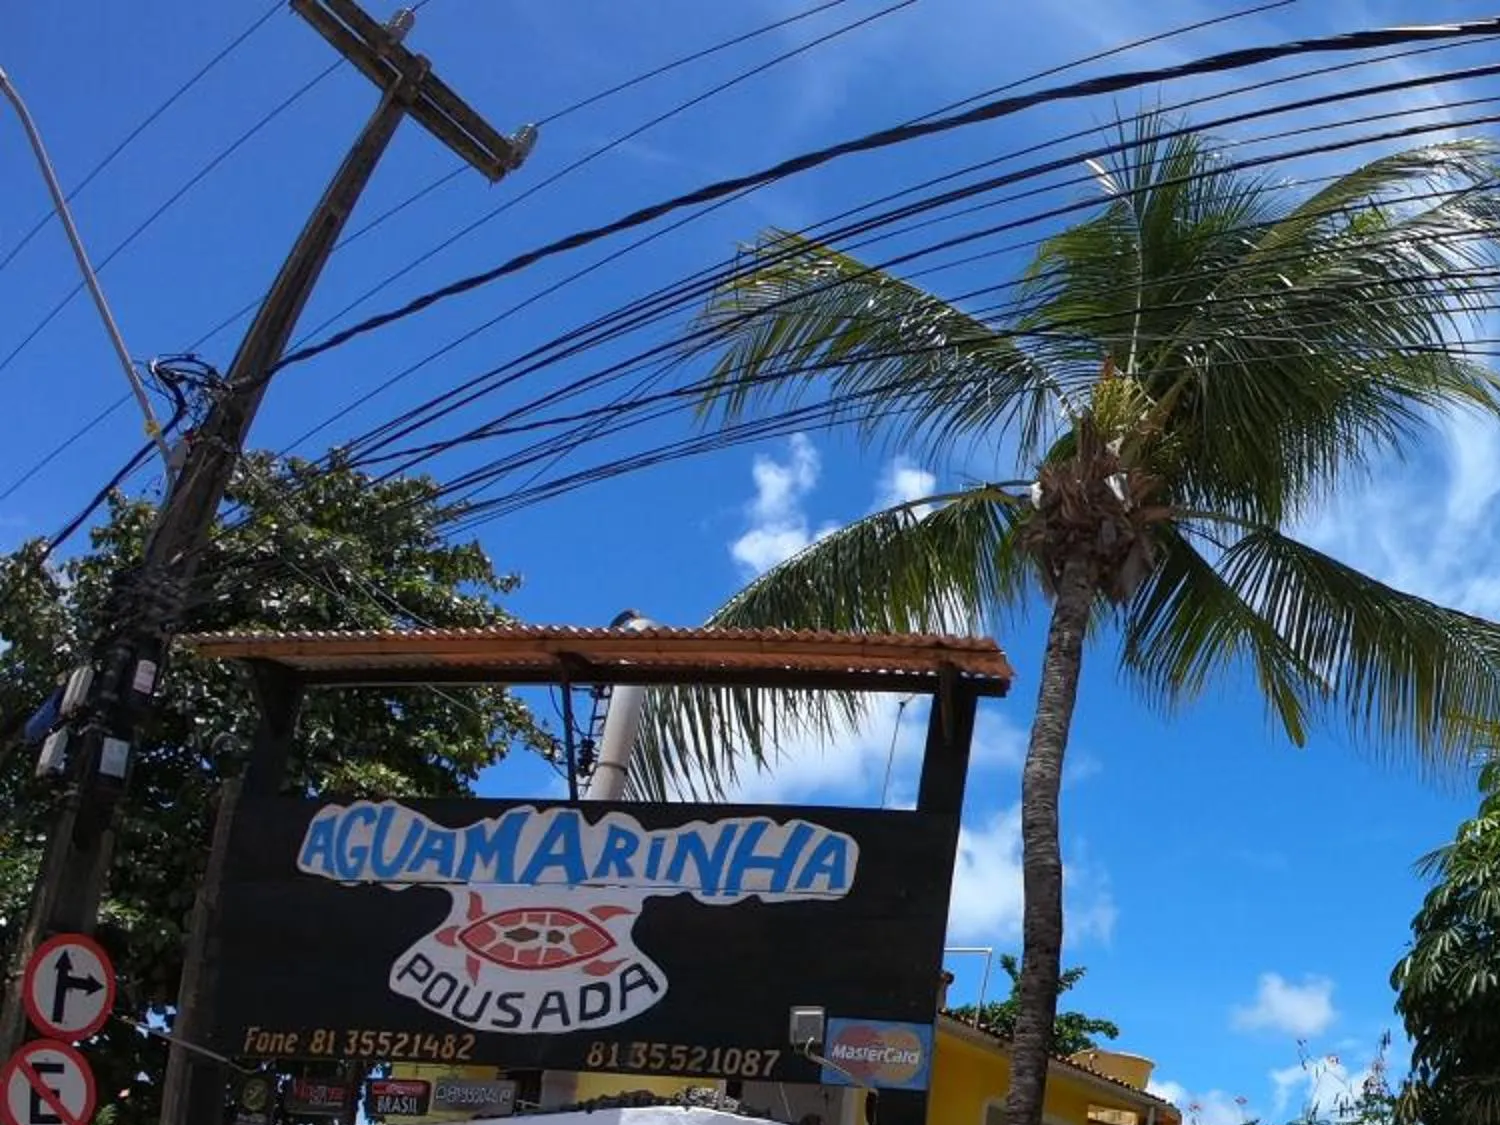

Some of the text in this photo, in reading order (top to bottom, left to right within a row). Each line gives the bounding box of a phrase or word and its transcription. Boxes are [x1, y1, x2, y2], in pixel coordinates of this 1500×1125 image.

[397, 952, 660, 1029] POUSADA
[243, 1026, 477, 1060] Fone 81 35521482
[587, 1041, 780, 1077] 81 35521087
[831, 1044, 920, 1065] MasterCard
[30, 1062, 64, 1125] E
